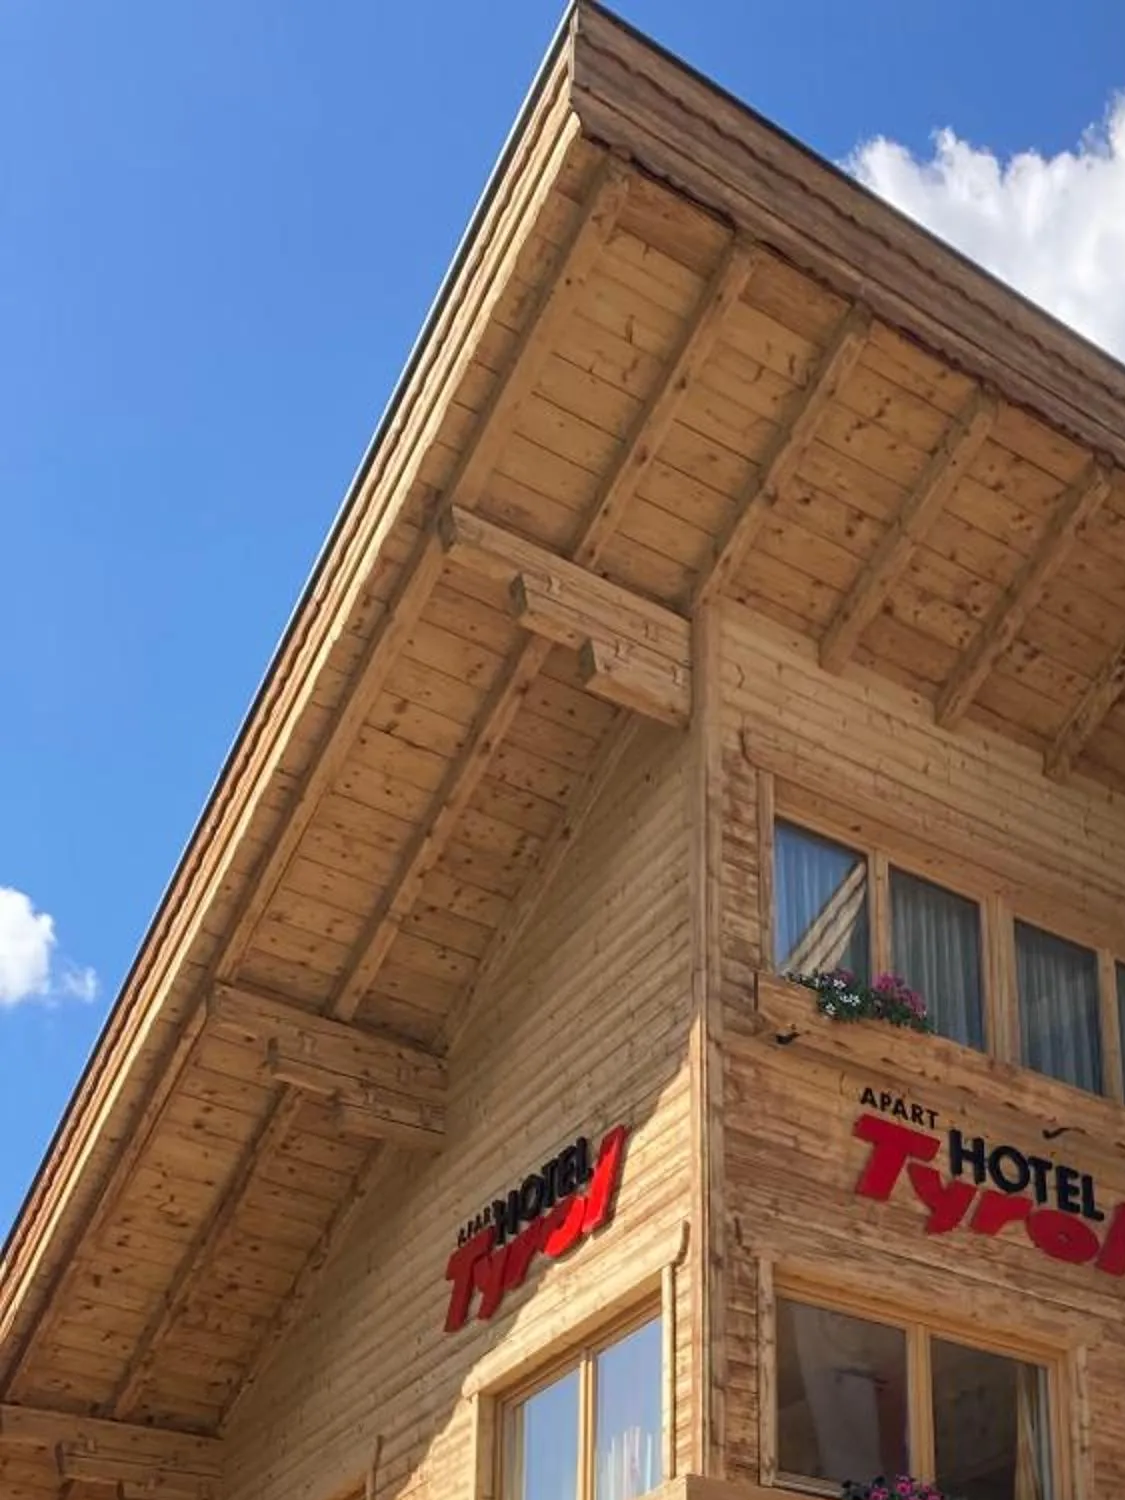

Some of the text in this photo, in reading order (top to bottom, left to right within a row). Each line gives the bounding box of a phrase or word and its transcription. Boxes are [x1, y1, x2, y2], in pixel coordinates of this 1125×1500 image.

[493, 1136, 594, 1246] HOTEL
[859, 1086, 1105, 1222] APART HOTEL
[443, 1124, 629, 1333] Tyrol
